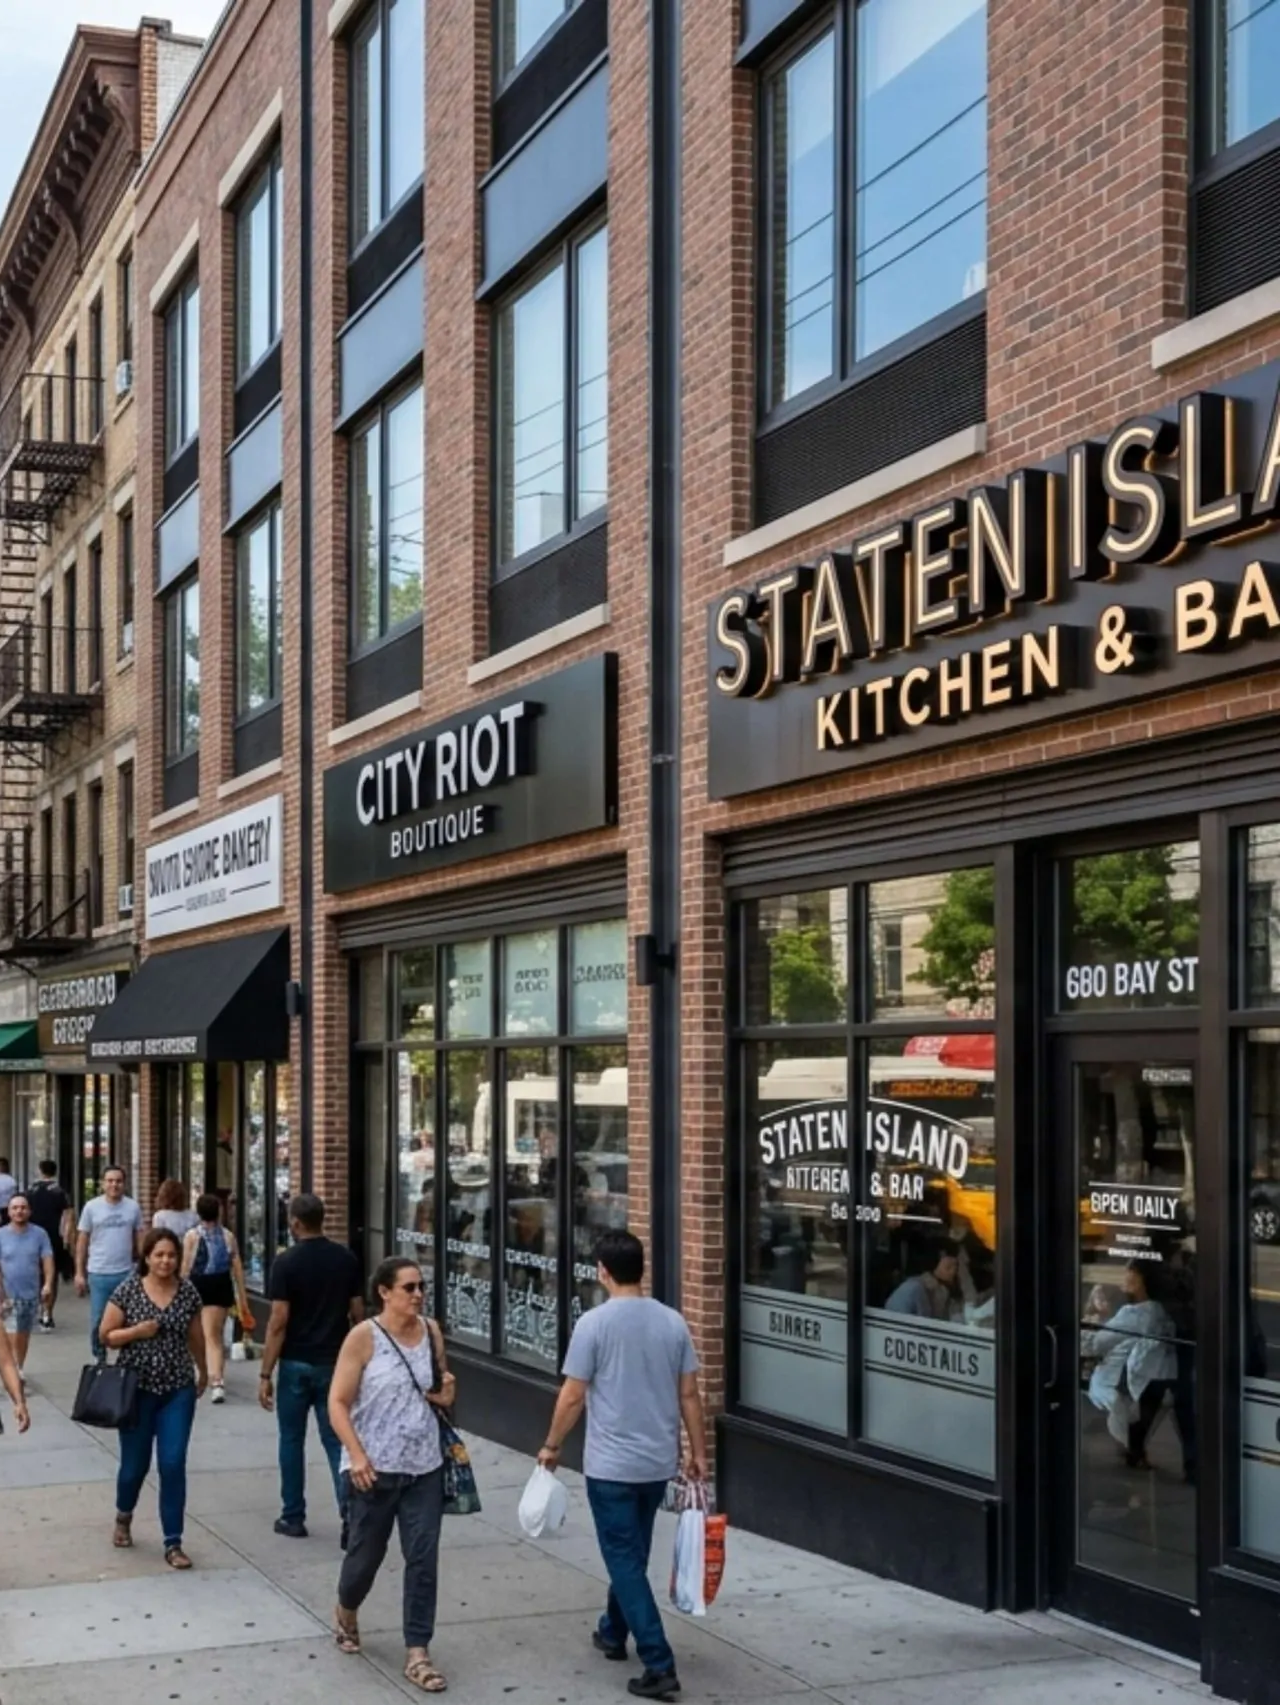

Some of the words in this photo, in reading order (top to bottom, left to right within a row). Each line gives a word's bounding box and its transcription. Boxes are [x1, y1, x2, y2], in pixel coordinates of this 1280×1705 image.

[716, 469, 1030, 697] STATEN
[817, 625, 1059, 750] KITCHEN
[1095, 605, 1134, 674] &
[356, 741, 426, 826] CITY
[436, 701, 524, 800] RIOT
[391, 805, 484, 858] BOUTIQUE
[1066, 966, 1107, 999] 680
[1114, 960, 1160, 996] BAY
[1168, 956, 1199, 993] ST
[759, 1109, 848, 1164] STATEN
[866, 1111, 968, 1179] ISLAND
[870, 1171, 884, 1197] &
[889, 1173, 924, 1201] BAR
[1134, 1194, 1179, 1220] DAILY
